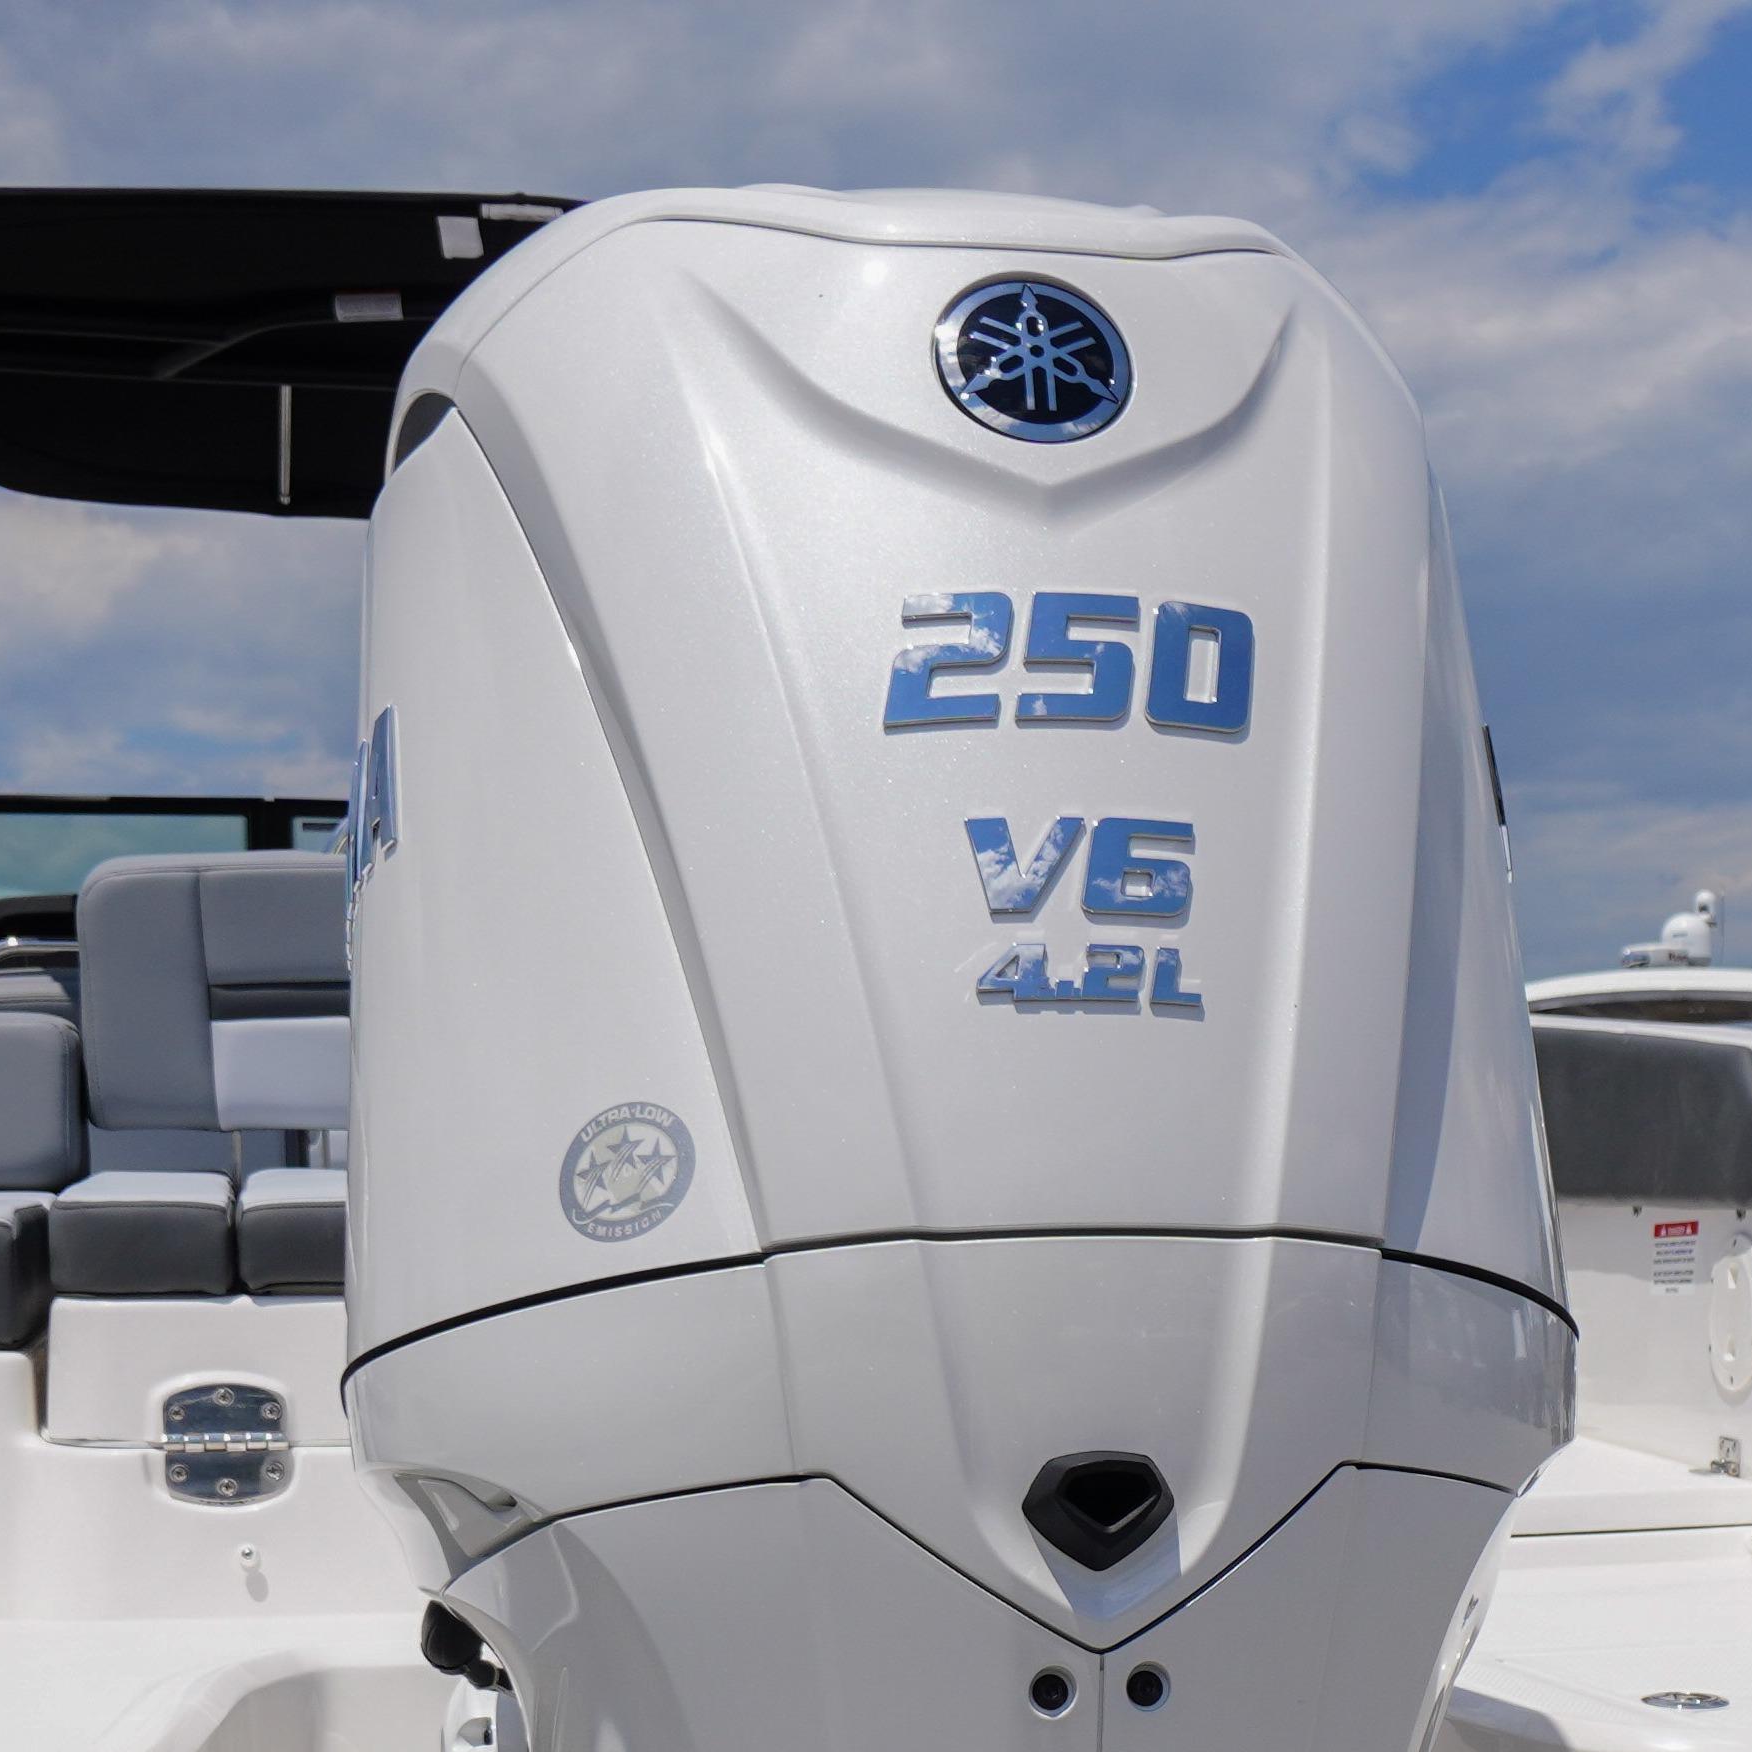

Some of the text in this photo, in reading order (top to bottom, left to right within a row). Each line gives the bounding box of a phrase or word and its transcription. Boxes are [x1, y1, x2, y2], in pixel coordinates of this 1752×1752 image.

[884, 591, 1253, 734] 250
[964, 816, 1195, 917] V6
[977, 943, 1203, 1007] 4.2L
[579, 1103, 677, 1143] ULTRA-LOW
[587, 1208, 664, 1238] EMISSION
